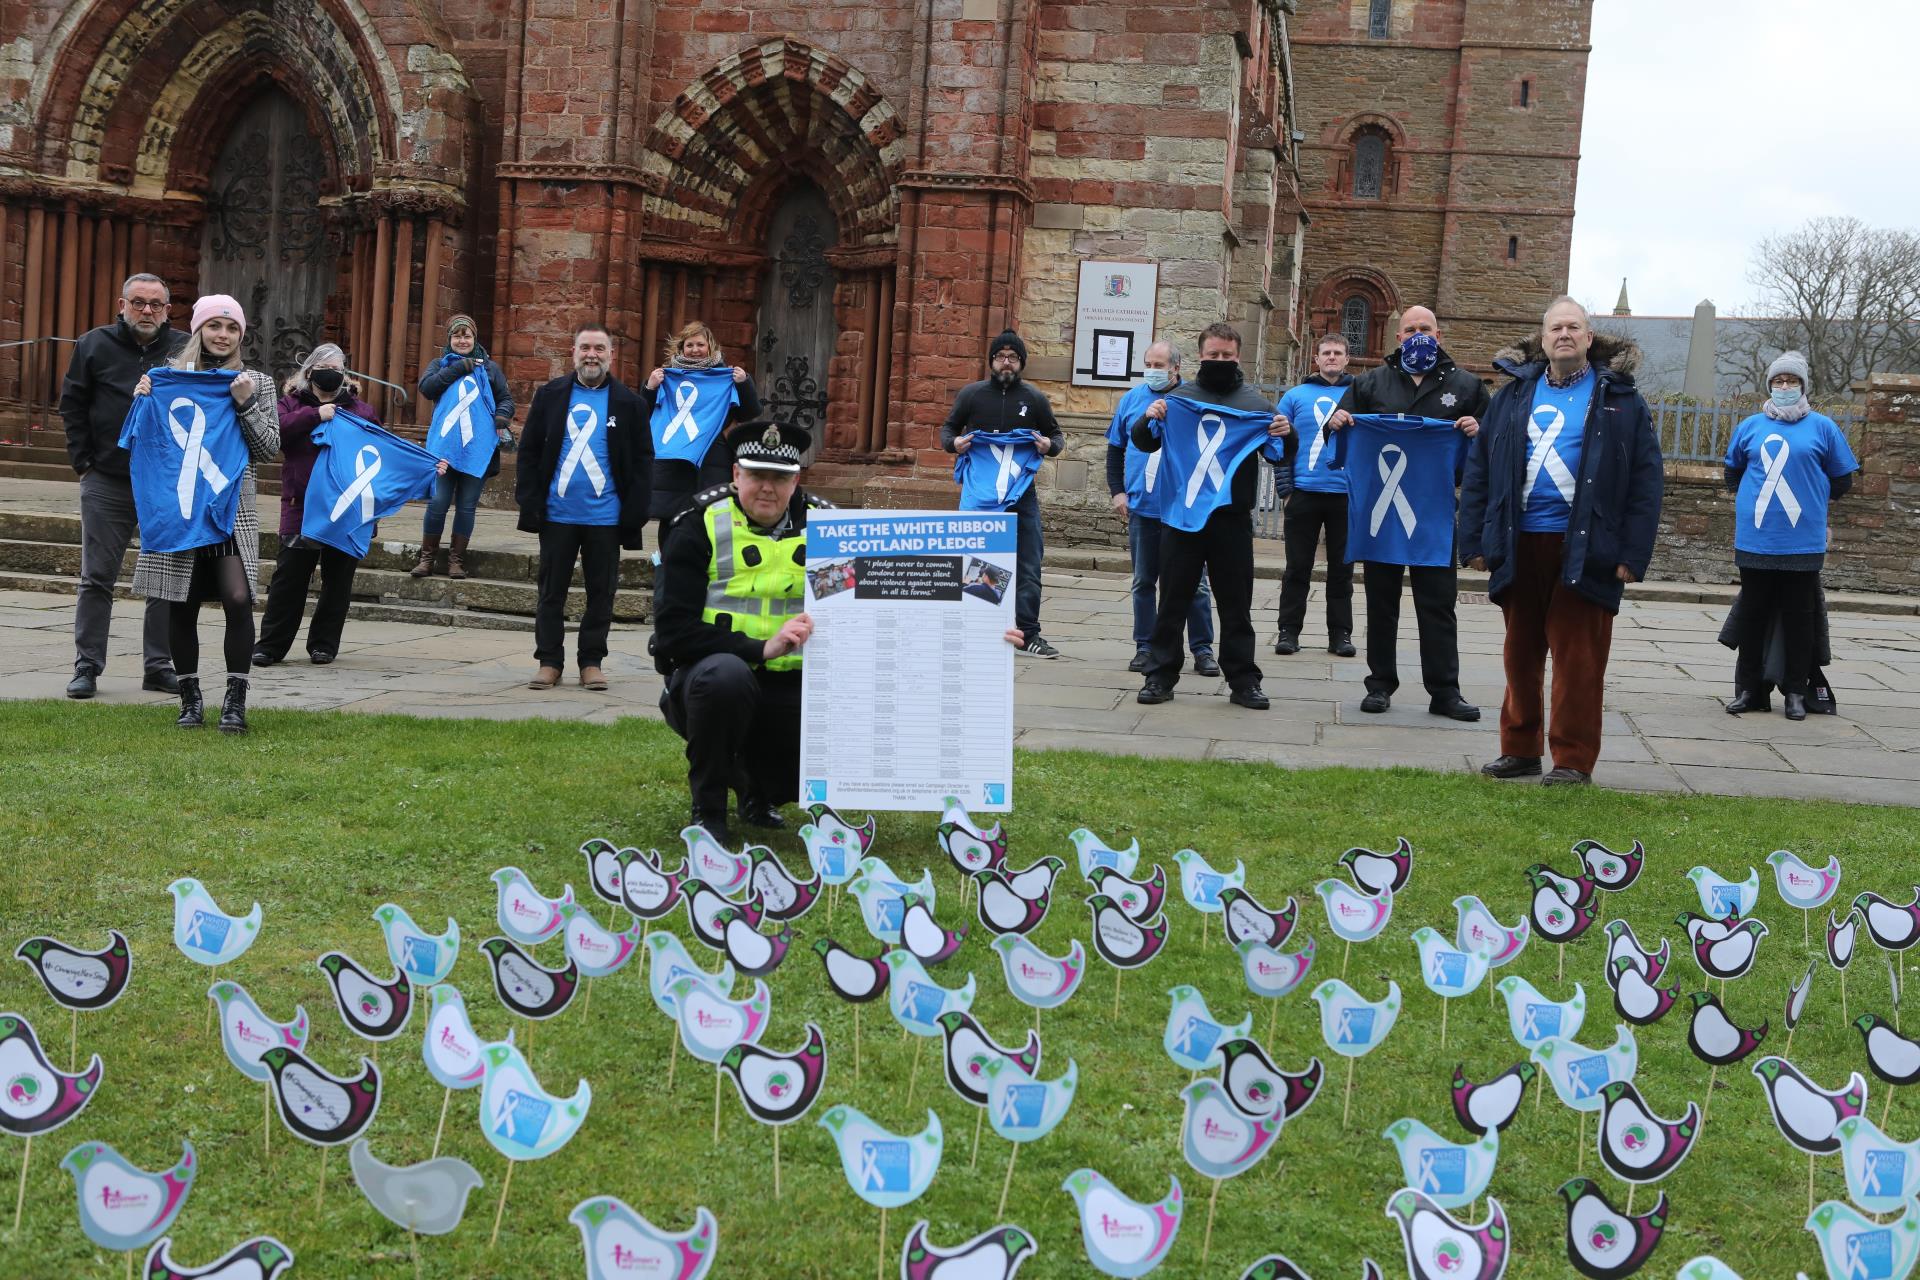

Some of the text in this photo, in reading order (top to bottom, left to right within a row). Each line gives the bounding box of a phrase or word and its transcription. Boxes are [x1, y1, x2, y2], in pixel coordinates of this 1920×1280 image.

[817, 520, 1007, 538] TAKE THE WHITE RIBBON
[838, 537, 986, 554] SCOTLAND PLEDGE
[872, 560, 894, 569] pledge
